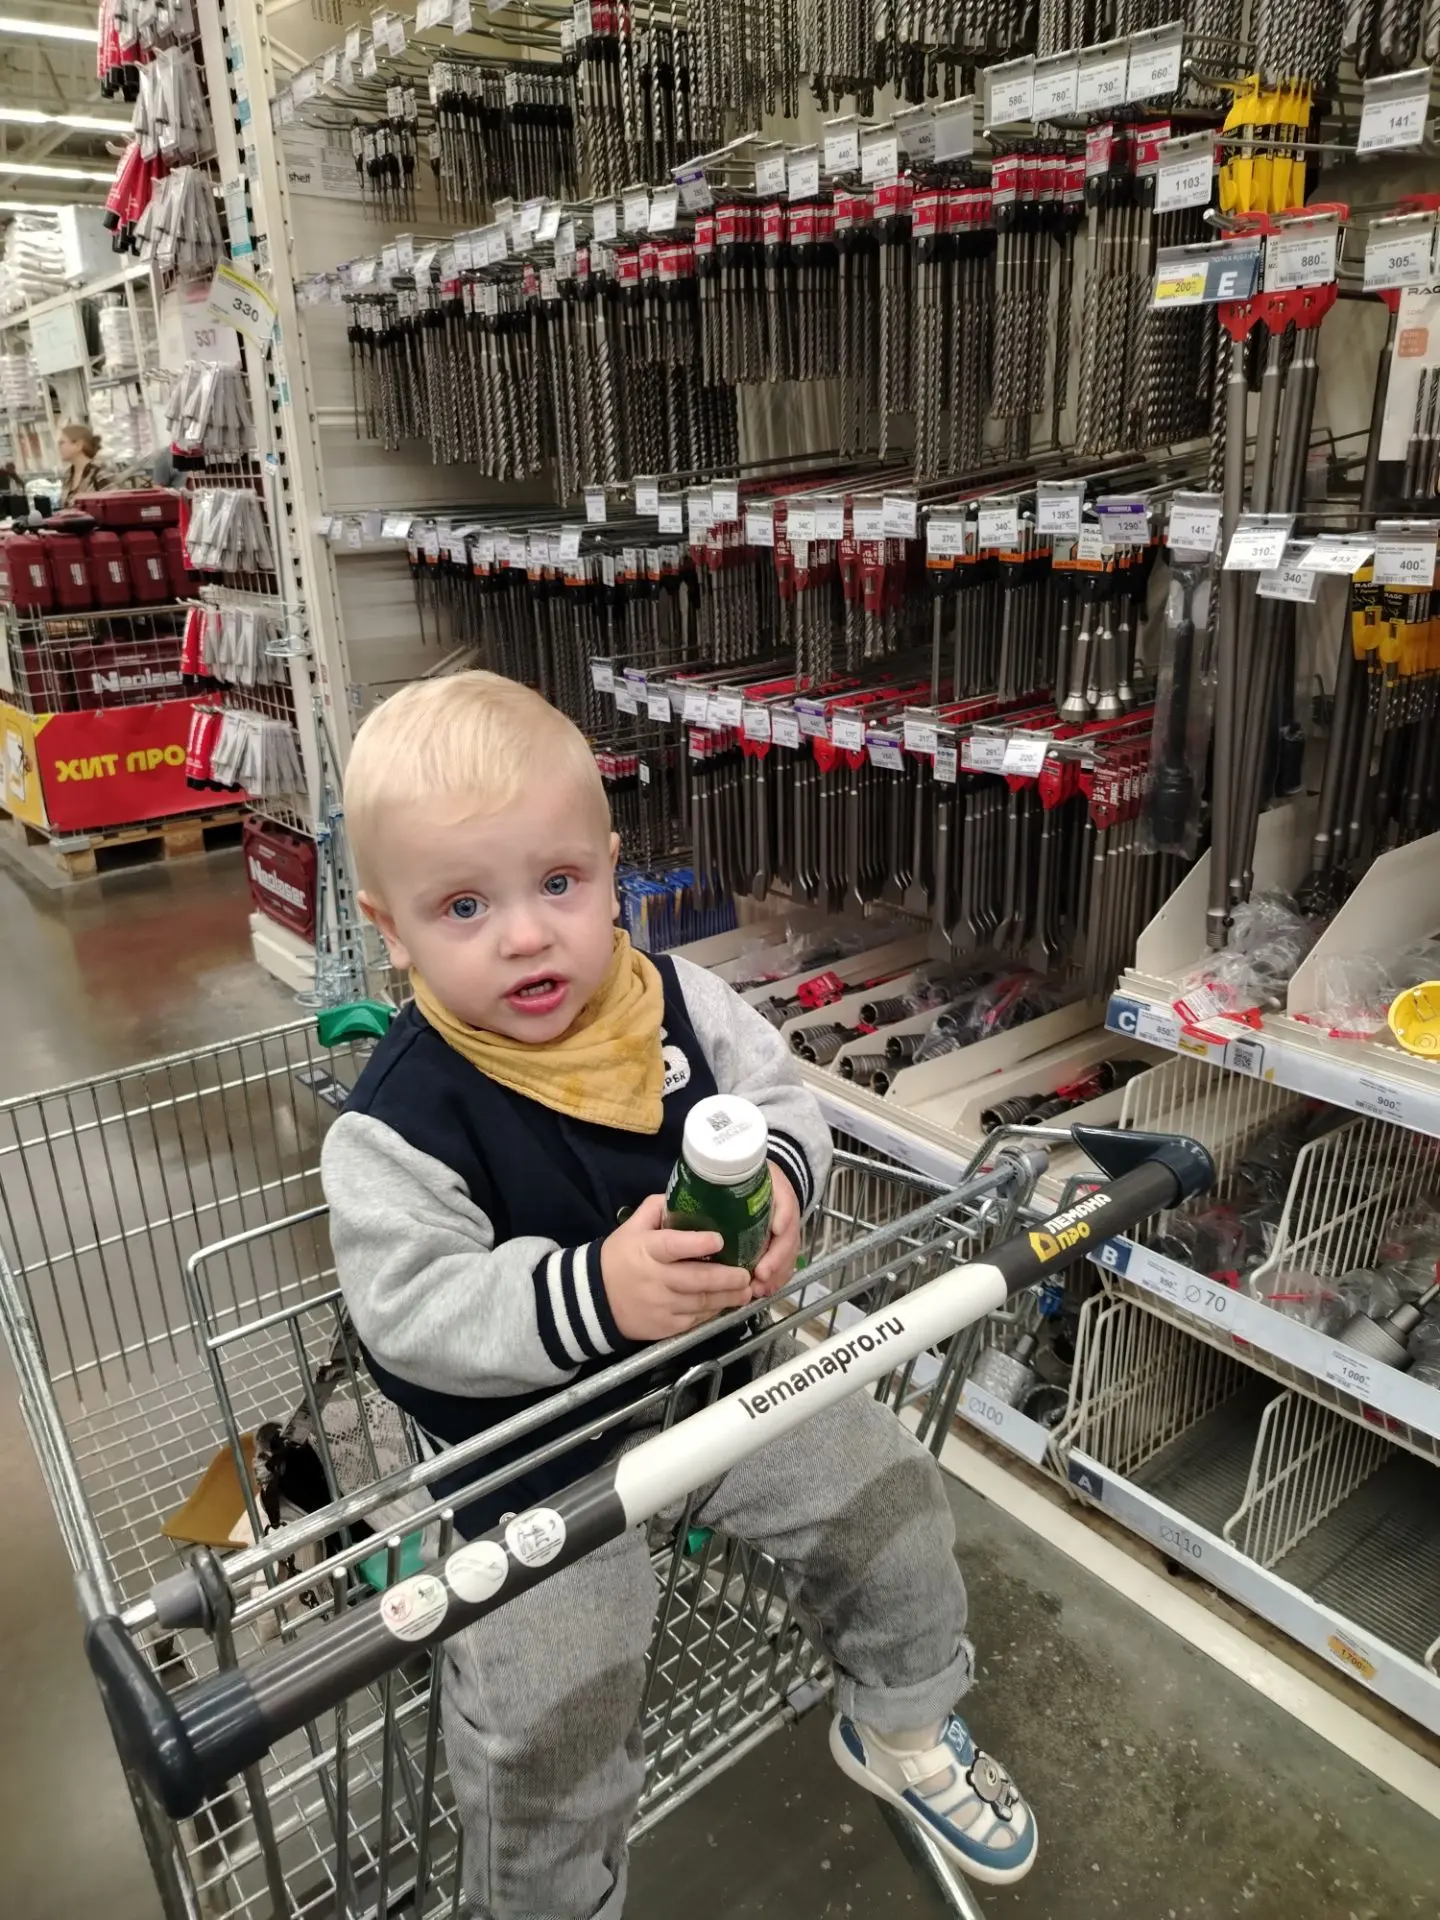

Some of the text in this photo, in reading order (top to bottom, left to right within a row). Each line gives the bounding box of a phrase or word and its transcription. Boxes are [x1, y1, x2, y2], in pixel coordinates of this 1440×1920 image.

[1098, 80, 1113, 94] 730
[1389, 114, 1408, 130] 141
[1301, 254, 1321, 268] 880
[1388, 255, 1410, 270] 305
[1217, 271, 1238, 297] E
[1407, 284, 1440, 296] RAG
[231, 297, 260, 323] 330
[1190, 525, 1206, 535] 141
[1398, 560, 1420, 572] 400
[1282, 572, 1303, 584] 340
[55, 744, 186, 782] ХИТ ПРО
[1118, 1011, 1137, 1032] C
[662, 1070, 687, 1089] PER
[1377, 1096, 1396, 1110] 900
[1043, 1193, 1112, 1235] ЛЕМАНА
[1056, 1221, 1091, 1250] ПРО
[1101, 1244, 1119, 1266] B
[738, 1316, 906, 1420] lemanapro.ru
[1078, 1474, 1093, 1493] A
